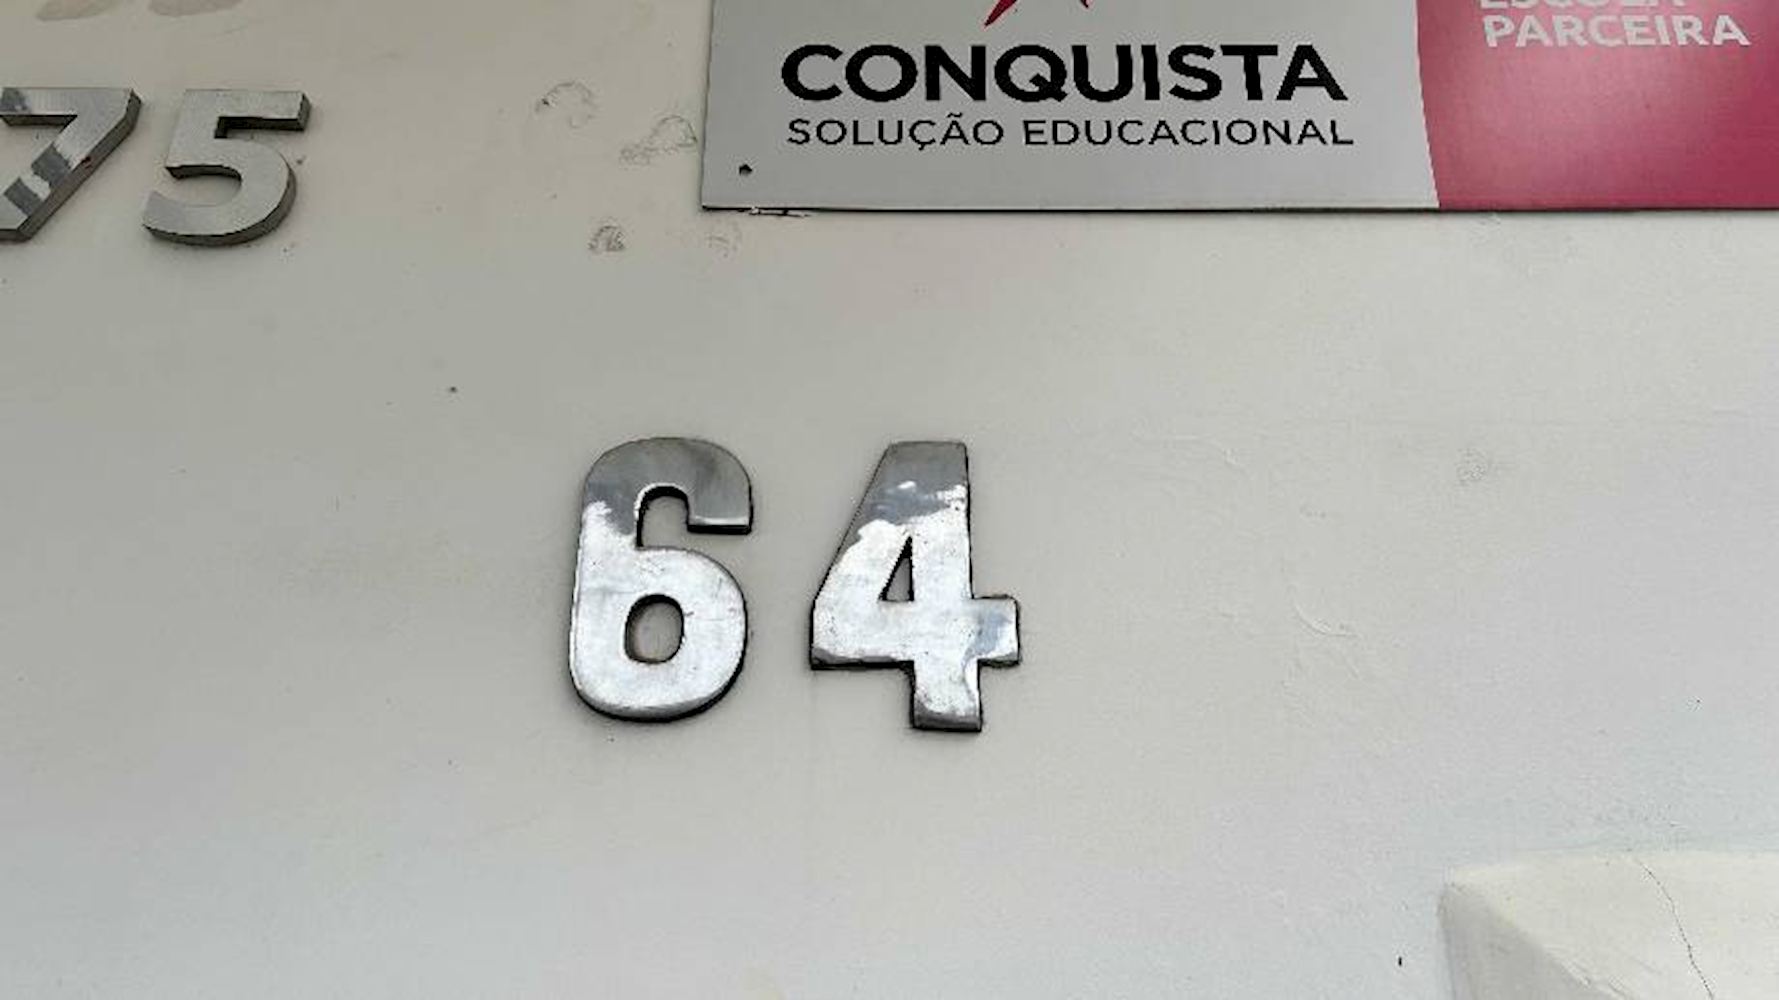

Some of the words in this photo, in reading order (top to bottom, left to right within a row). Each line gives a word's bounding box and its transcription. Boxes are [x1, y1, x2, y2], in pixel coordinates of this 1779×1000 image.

[1483, 15, 1751, 48] PARCEIRA
[781, 44, 1348, 102] CONQUISTA
[787, 113, 1003, 149] SOLUÇÃO
[1023, 118, 1354, 146] EDUCACIONAL
[0, 87, 311, 247] 75
[568, 437, 1021, 731] 64
